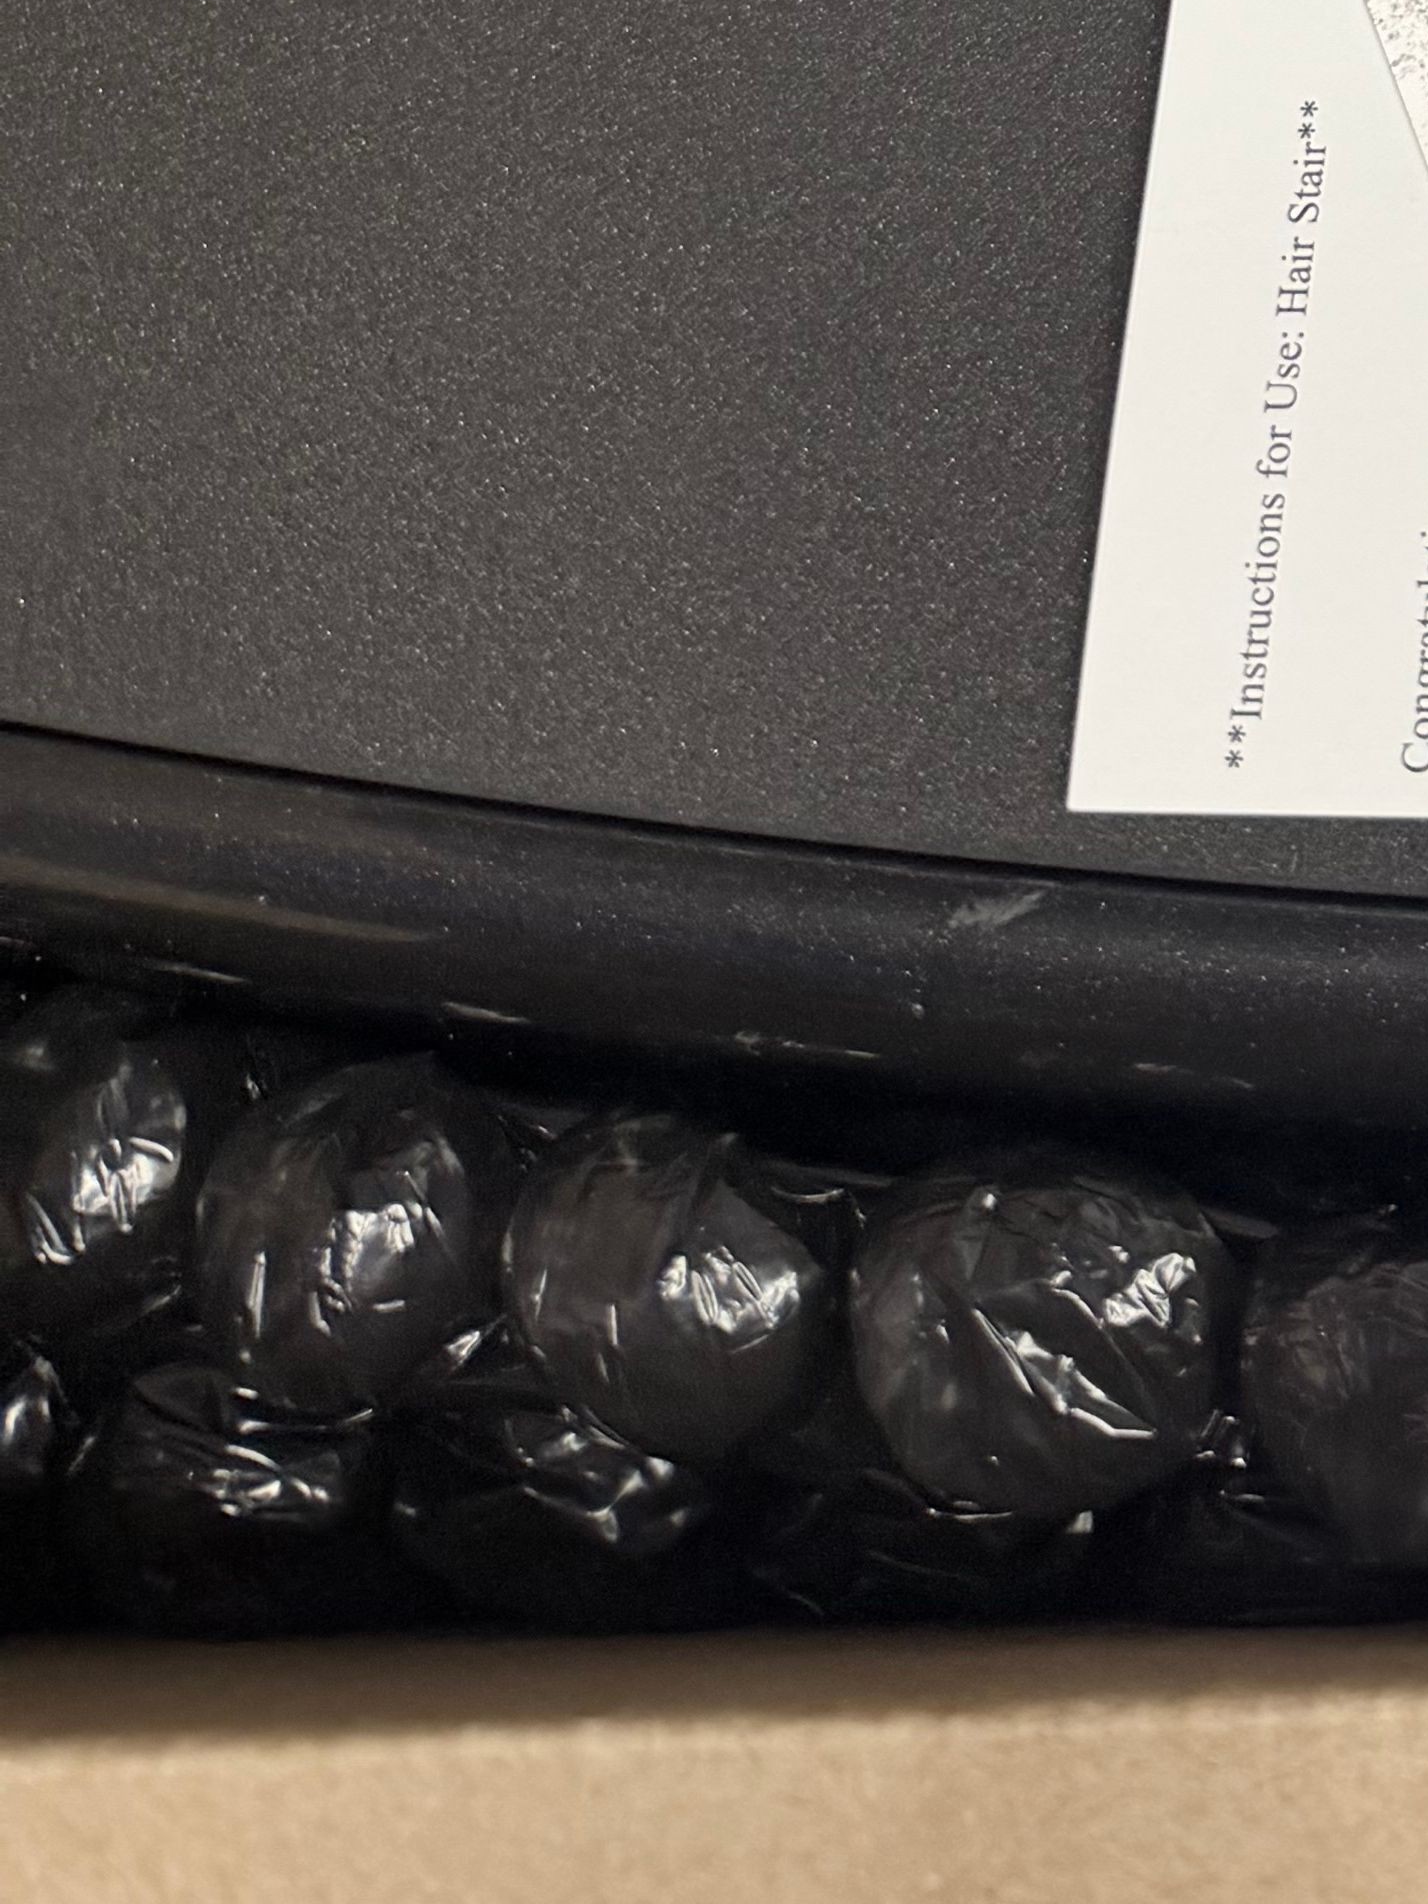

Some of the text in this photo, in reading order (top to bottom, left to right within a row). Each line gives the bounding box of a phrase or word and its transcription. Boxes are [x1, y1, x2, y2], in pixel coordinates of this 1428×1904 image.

[1275, 235, 1315, 317] Hair
[1263, 331, 1305, 414] Use:
[1255, 424, 1293, 479] for
